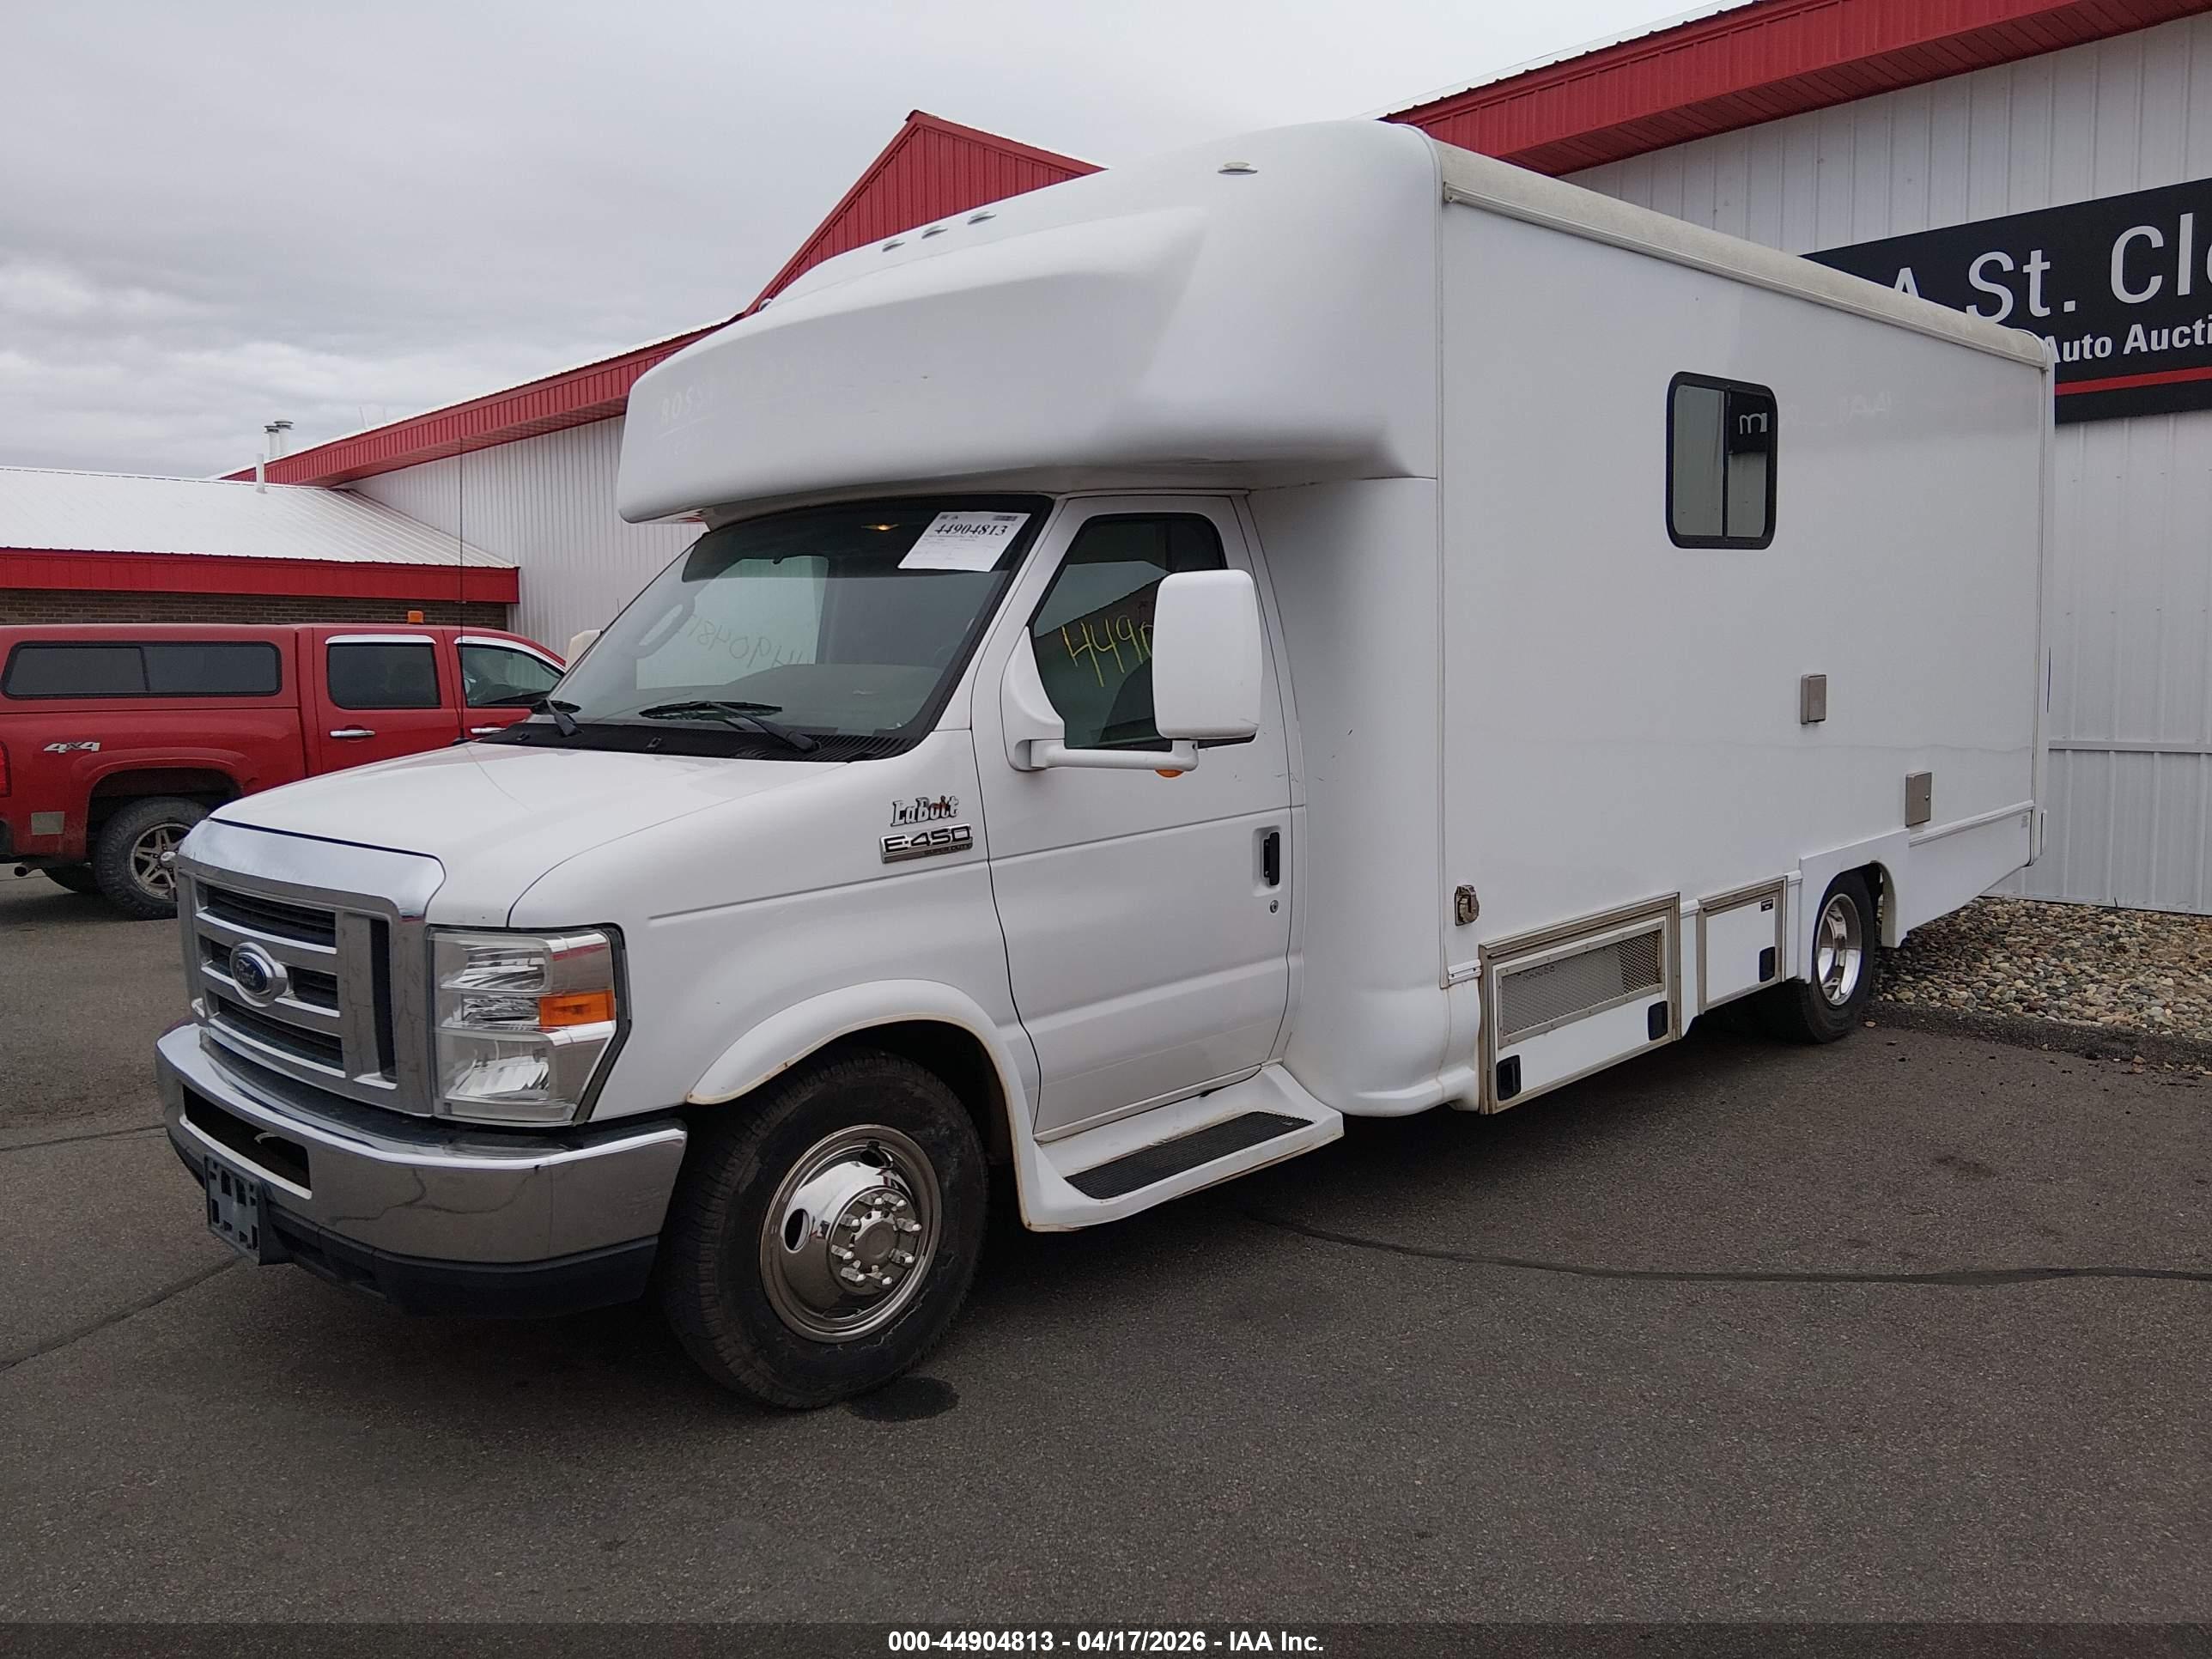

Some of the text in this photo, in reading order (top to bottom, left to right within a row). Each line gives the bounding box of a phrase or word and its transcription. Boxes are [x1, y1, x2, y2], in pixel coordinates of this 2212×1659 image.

[1966, 212, 2212, 324] St. Cl
[2044, 333, 2112, 363] Auto
[934, 523, 1009, 537] 44904813
